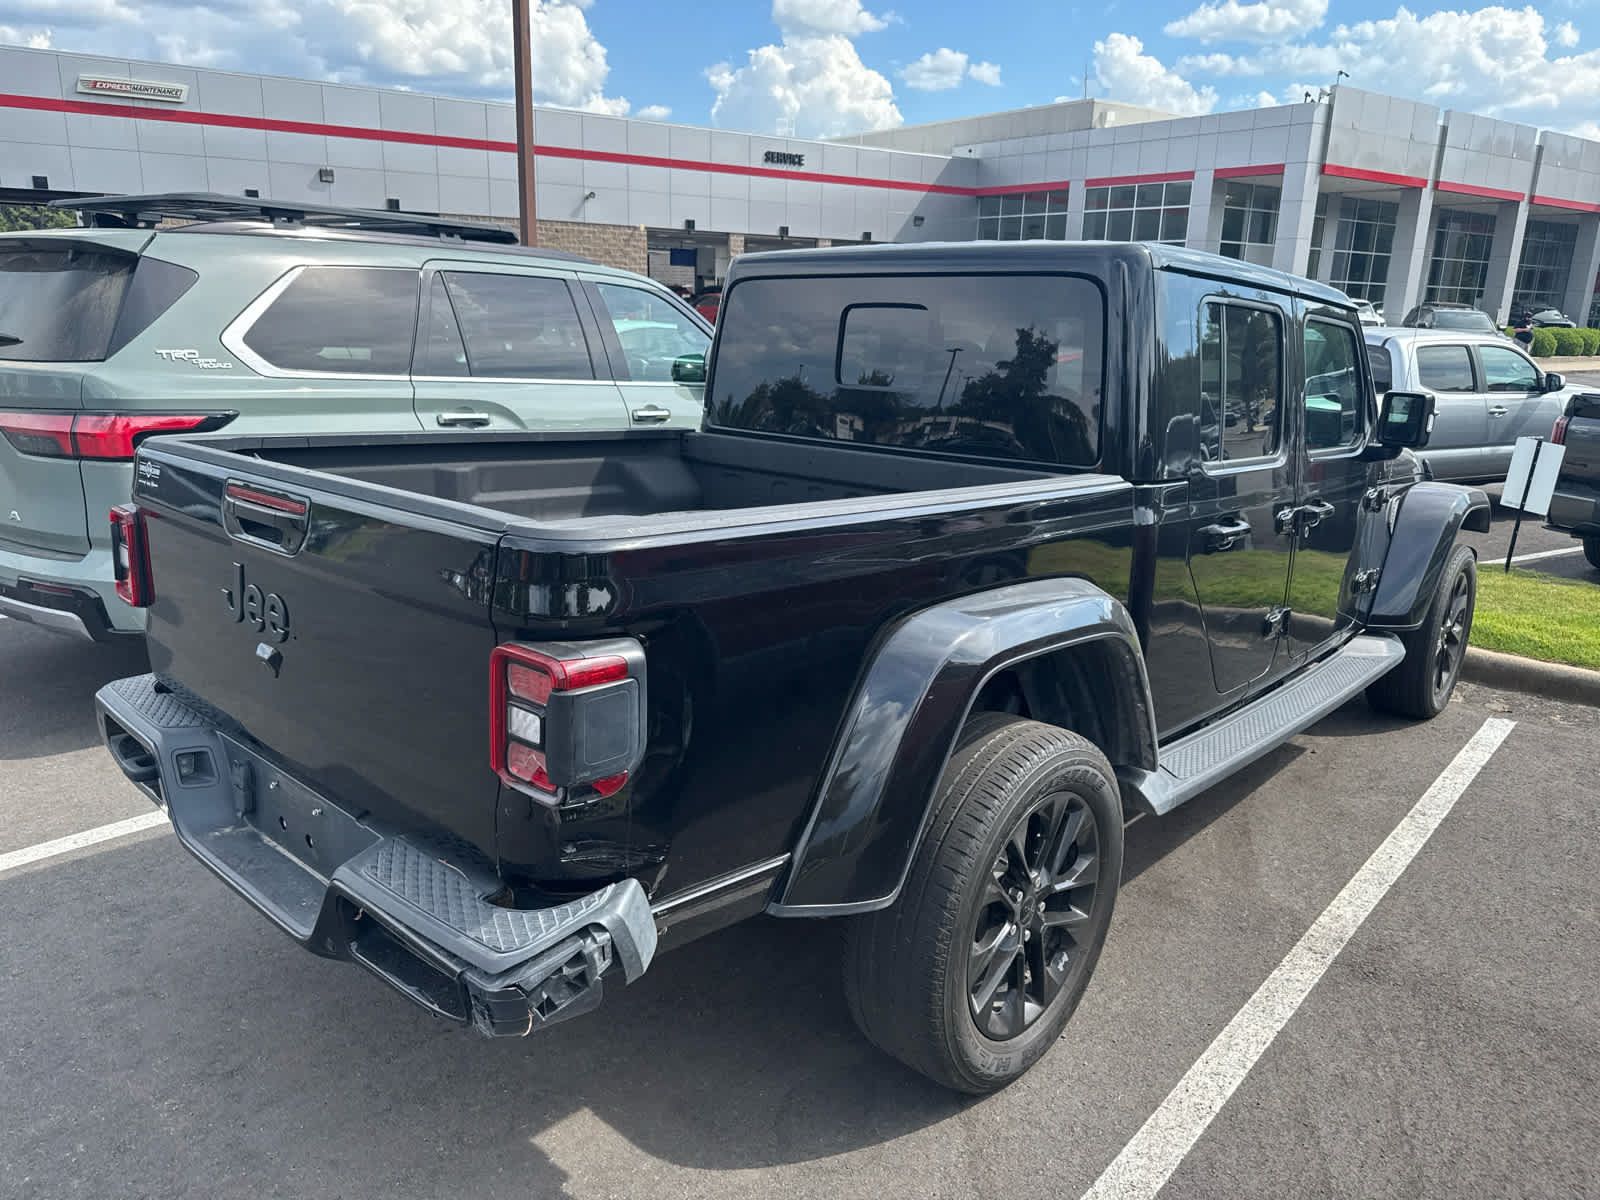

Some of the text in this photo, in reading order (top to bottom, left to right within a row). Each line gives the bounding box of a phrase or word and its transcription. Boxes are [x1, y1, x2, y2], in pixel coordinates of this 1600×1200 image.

[95, 81, 180, 97] EXPRESS MAINTENANCE
[764, 150, 805, 167] SERVICE
[154, 349, 199, 361] TRD
[199, 362, 233, 370] ROAD
[221, 561, 290, 644] Jeep
